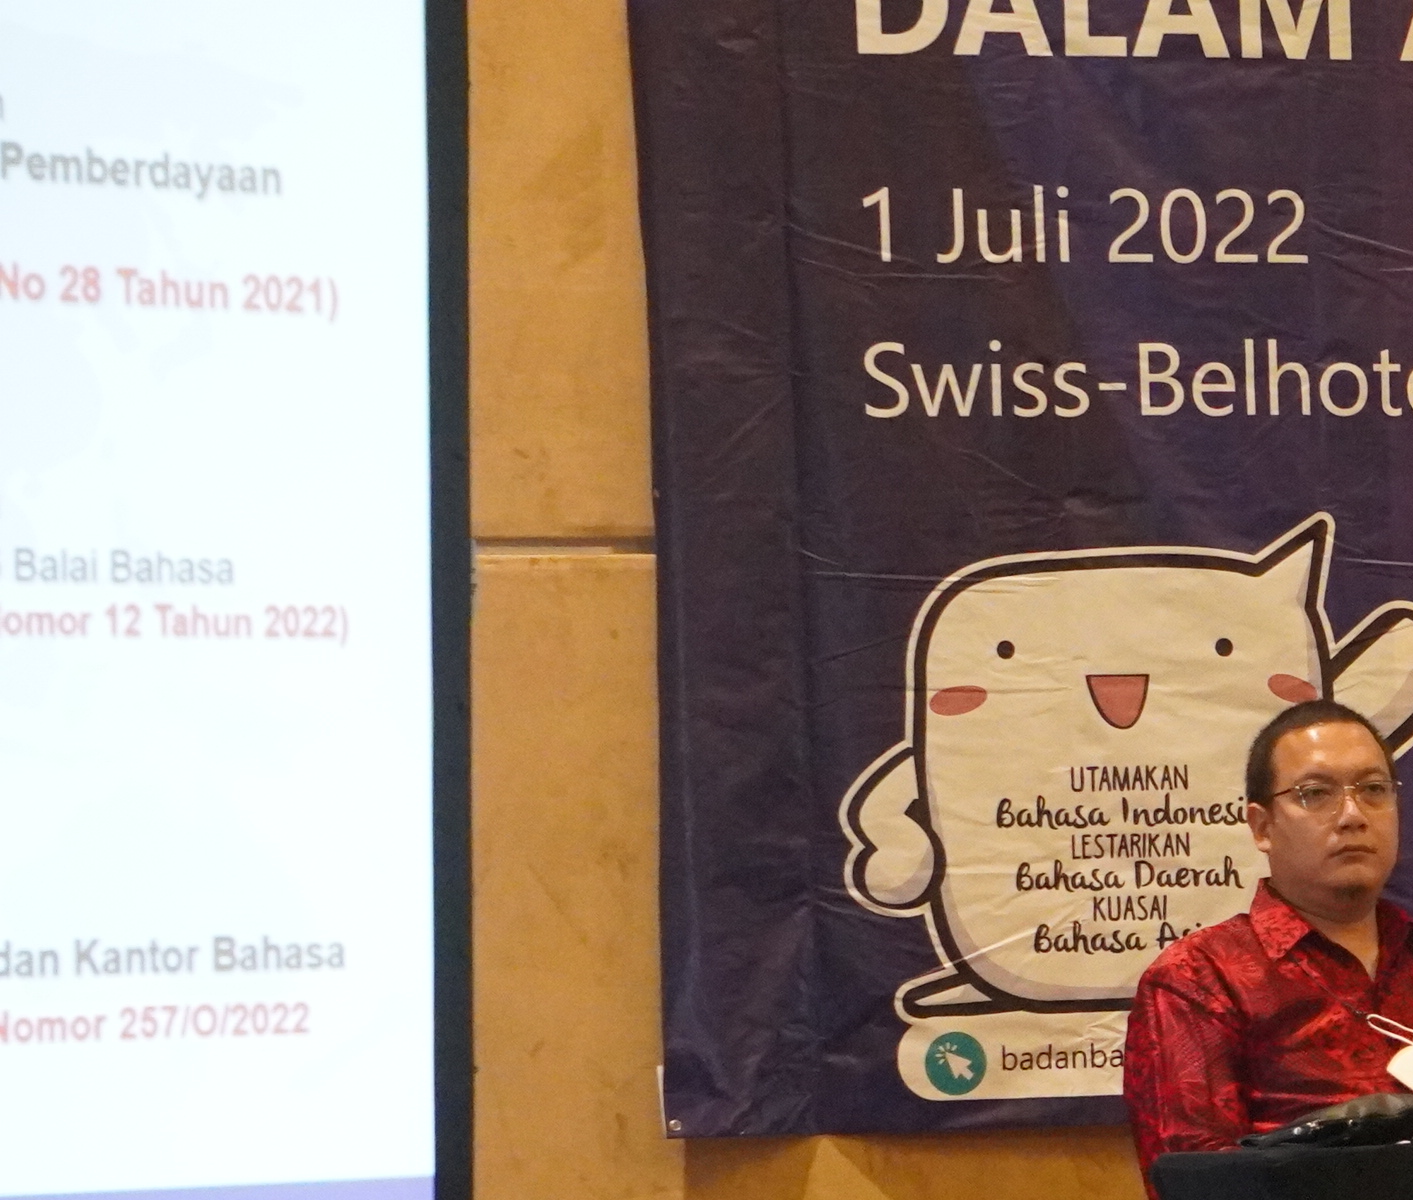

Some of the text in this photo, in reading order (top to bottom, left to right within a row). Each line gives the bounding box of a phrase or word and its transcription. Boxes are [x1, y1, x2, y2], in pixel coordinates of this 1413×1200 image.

[856, 0, 1351, 60] DALAM
[0, 140, 283, 200] Pemberdayaan
[863, 185, 1309, 264] 1 Juli 2022
[59, 264, 103, 304] 28
[116, 267, 229, 311] Tahun
[242, 274, 340, 323] 2021)
[15, 547, 235, 586] Balai Bahasa
[0, 602, 348, 647] omor 12 Tahun 2022)
[1070, 764, 1189, 792] UTAMAKAN
[996, 793, 1249, 830] Bahasa Indonesi
[1071, 832, 1191, 860] LESTARIKAN
[1016, 855, 1245, 892] Bahasa Daerah
[1093, 895, 1168, 921] KUASAI
[0, 935, 346, 977] dan Kantor Bahasa
[1034, 920, 1148, 954] Bahasa
[119, 1002, 311, 1041] 257/O/2022
